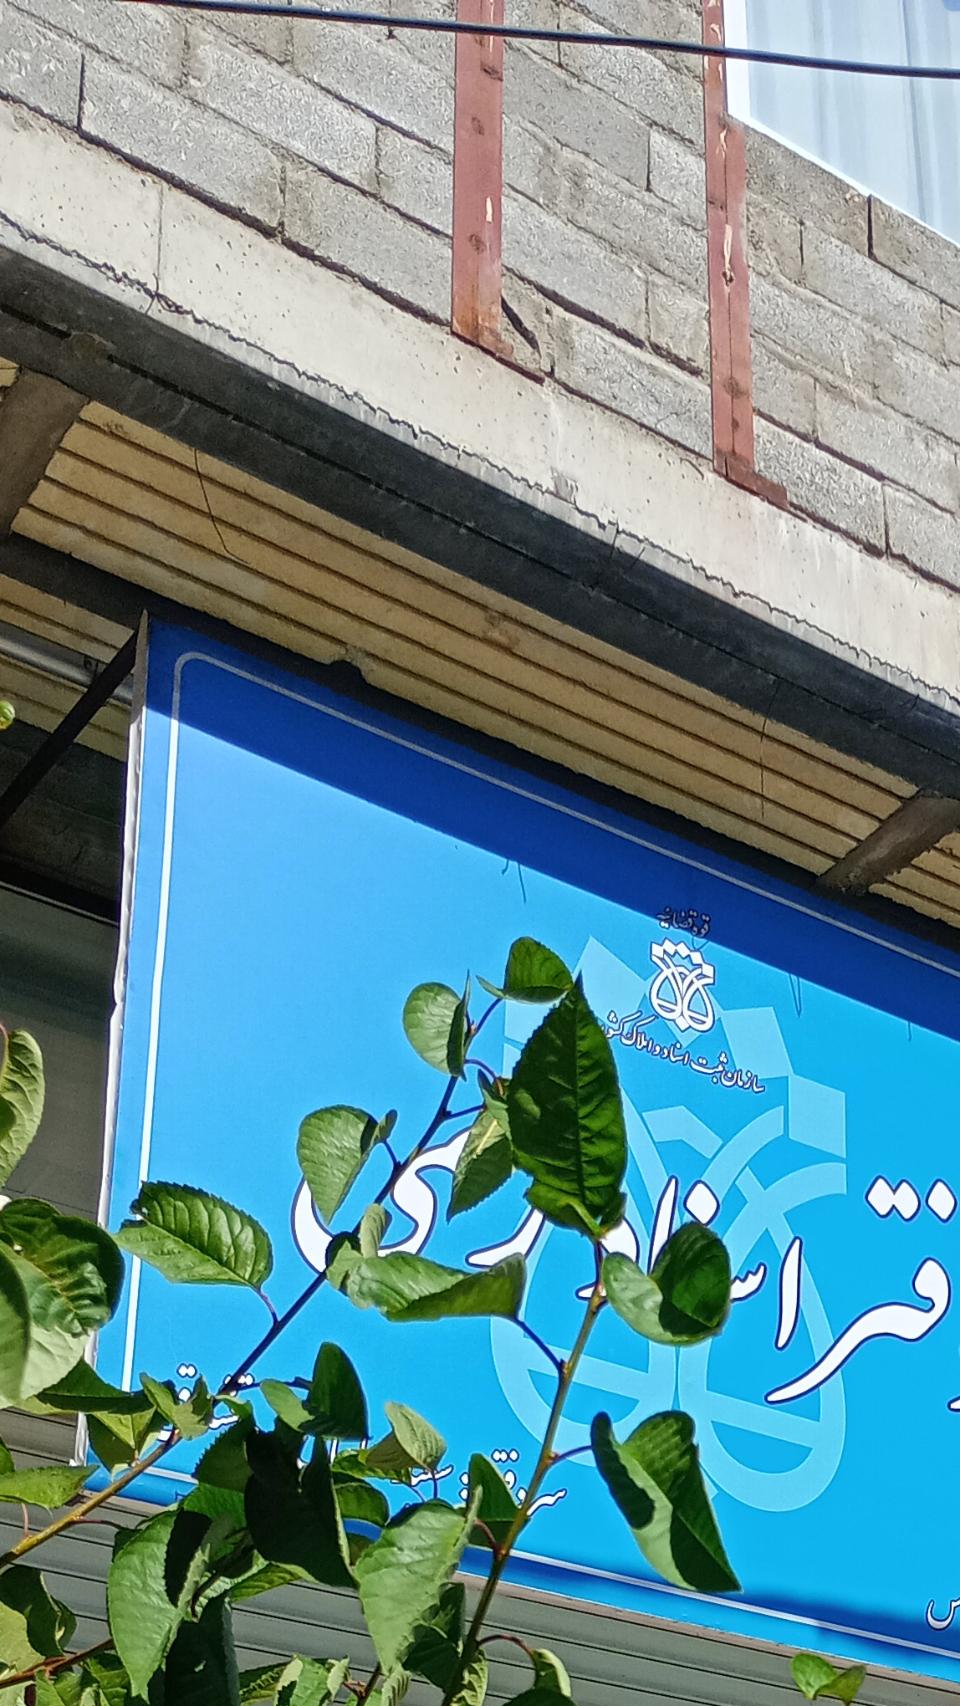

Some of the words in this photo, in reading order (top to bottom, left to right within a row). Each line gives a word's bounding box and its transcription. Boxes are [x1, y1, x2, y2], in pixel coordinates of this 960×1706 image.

[660, 1041, 689, 1065] اسناد
[690, 1051, 728, 1084] ثبت
[720, 1067, 765, 1093] سازمان
